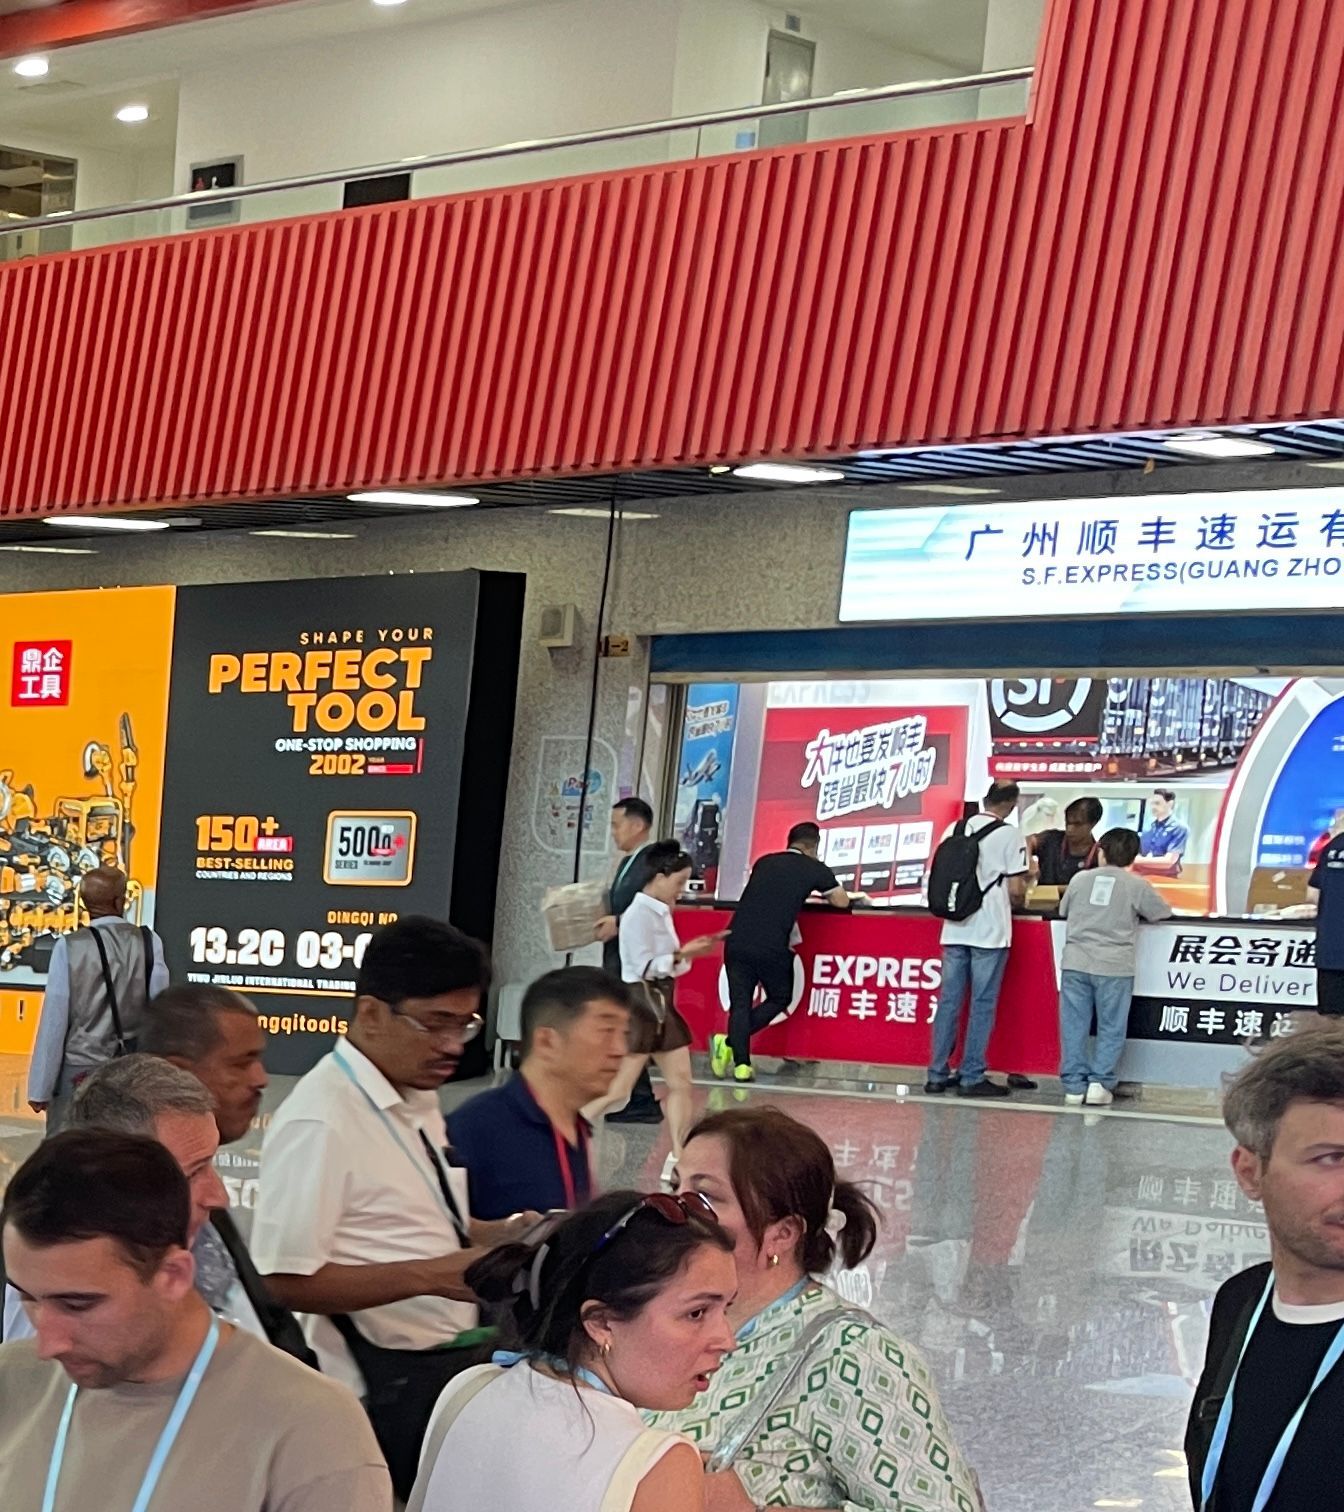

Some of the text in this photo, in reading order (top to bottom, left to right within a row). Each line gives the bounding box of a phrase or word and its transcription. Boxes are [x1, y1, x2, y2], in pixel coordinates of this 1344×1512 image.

[1022, 557, 1279, 585] S.F.EXPRESS(GUANG
[300, 627, 433, 645] SHAPE YOUR
[209, 647, 432, 693] PERFECT
[18, 675, 62, 699] 工具
[287, 690, 426, 732] TOOL
[274, 736, 417, 752] ONE-STOP SHOPPING
[308, 754, 366, 775] 2002
[196, 857, 294, 871] BEST-SELLING
[327, 910, 374, 926] DINGQI
[190, 927, 286, 967] 13.2C
[1169, 934, 1317, 968] 展会寄递
[245, 975, 314, 988] INTERNATIONAL
[316, 978, 356, 991] TRADING
[812, 954, 942, 991] EXPRES
[1167, 971, 1313, 996] We Deliver
[257, 1013, 349, 1035] ngqitools
